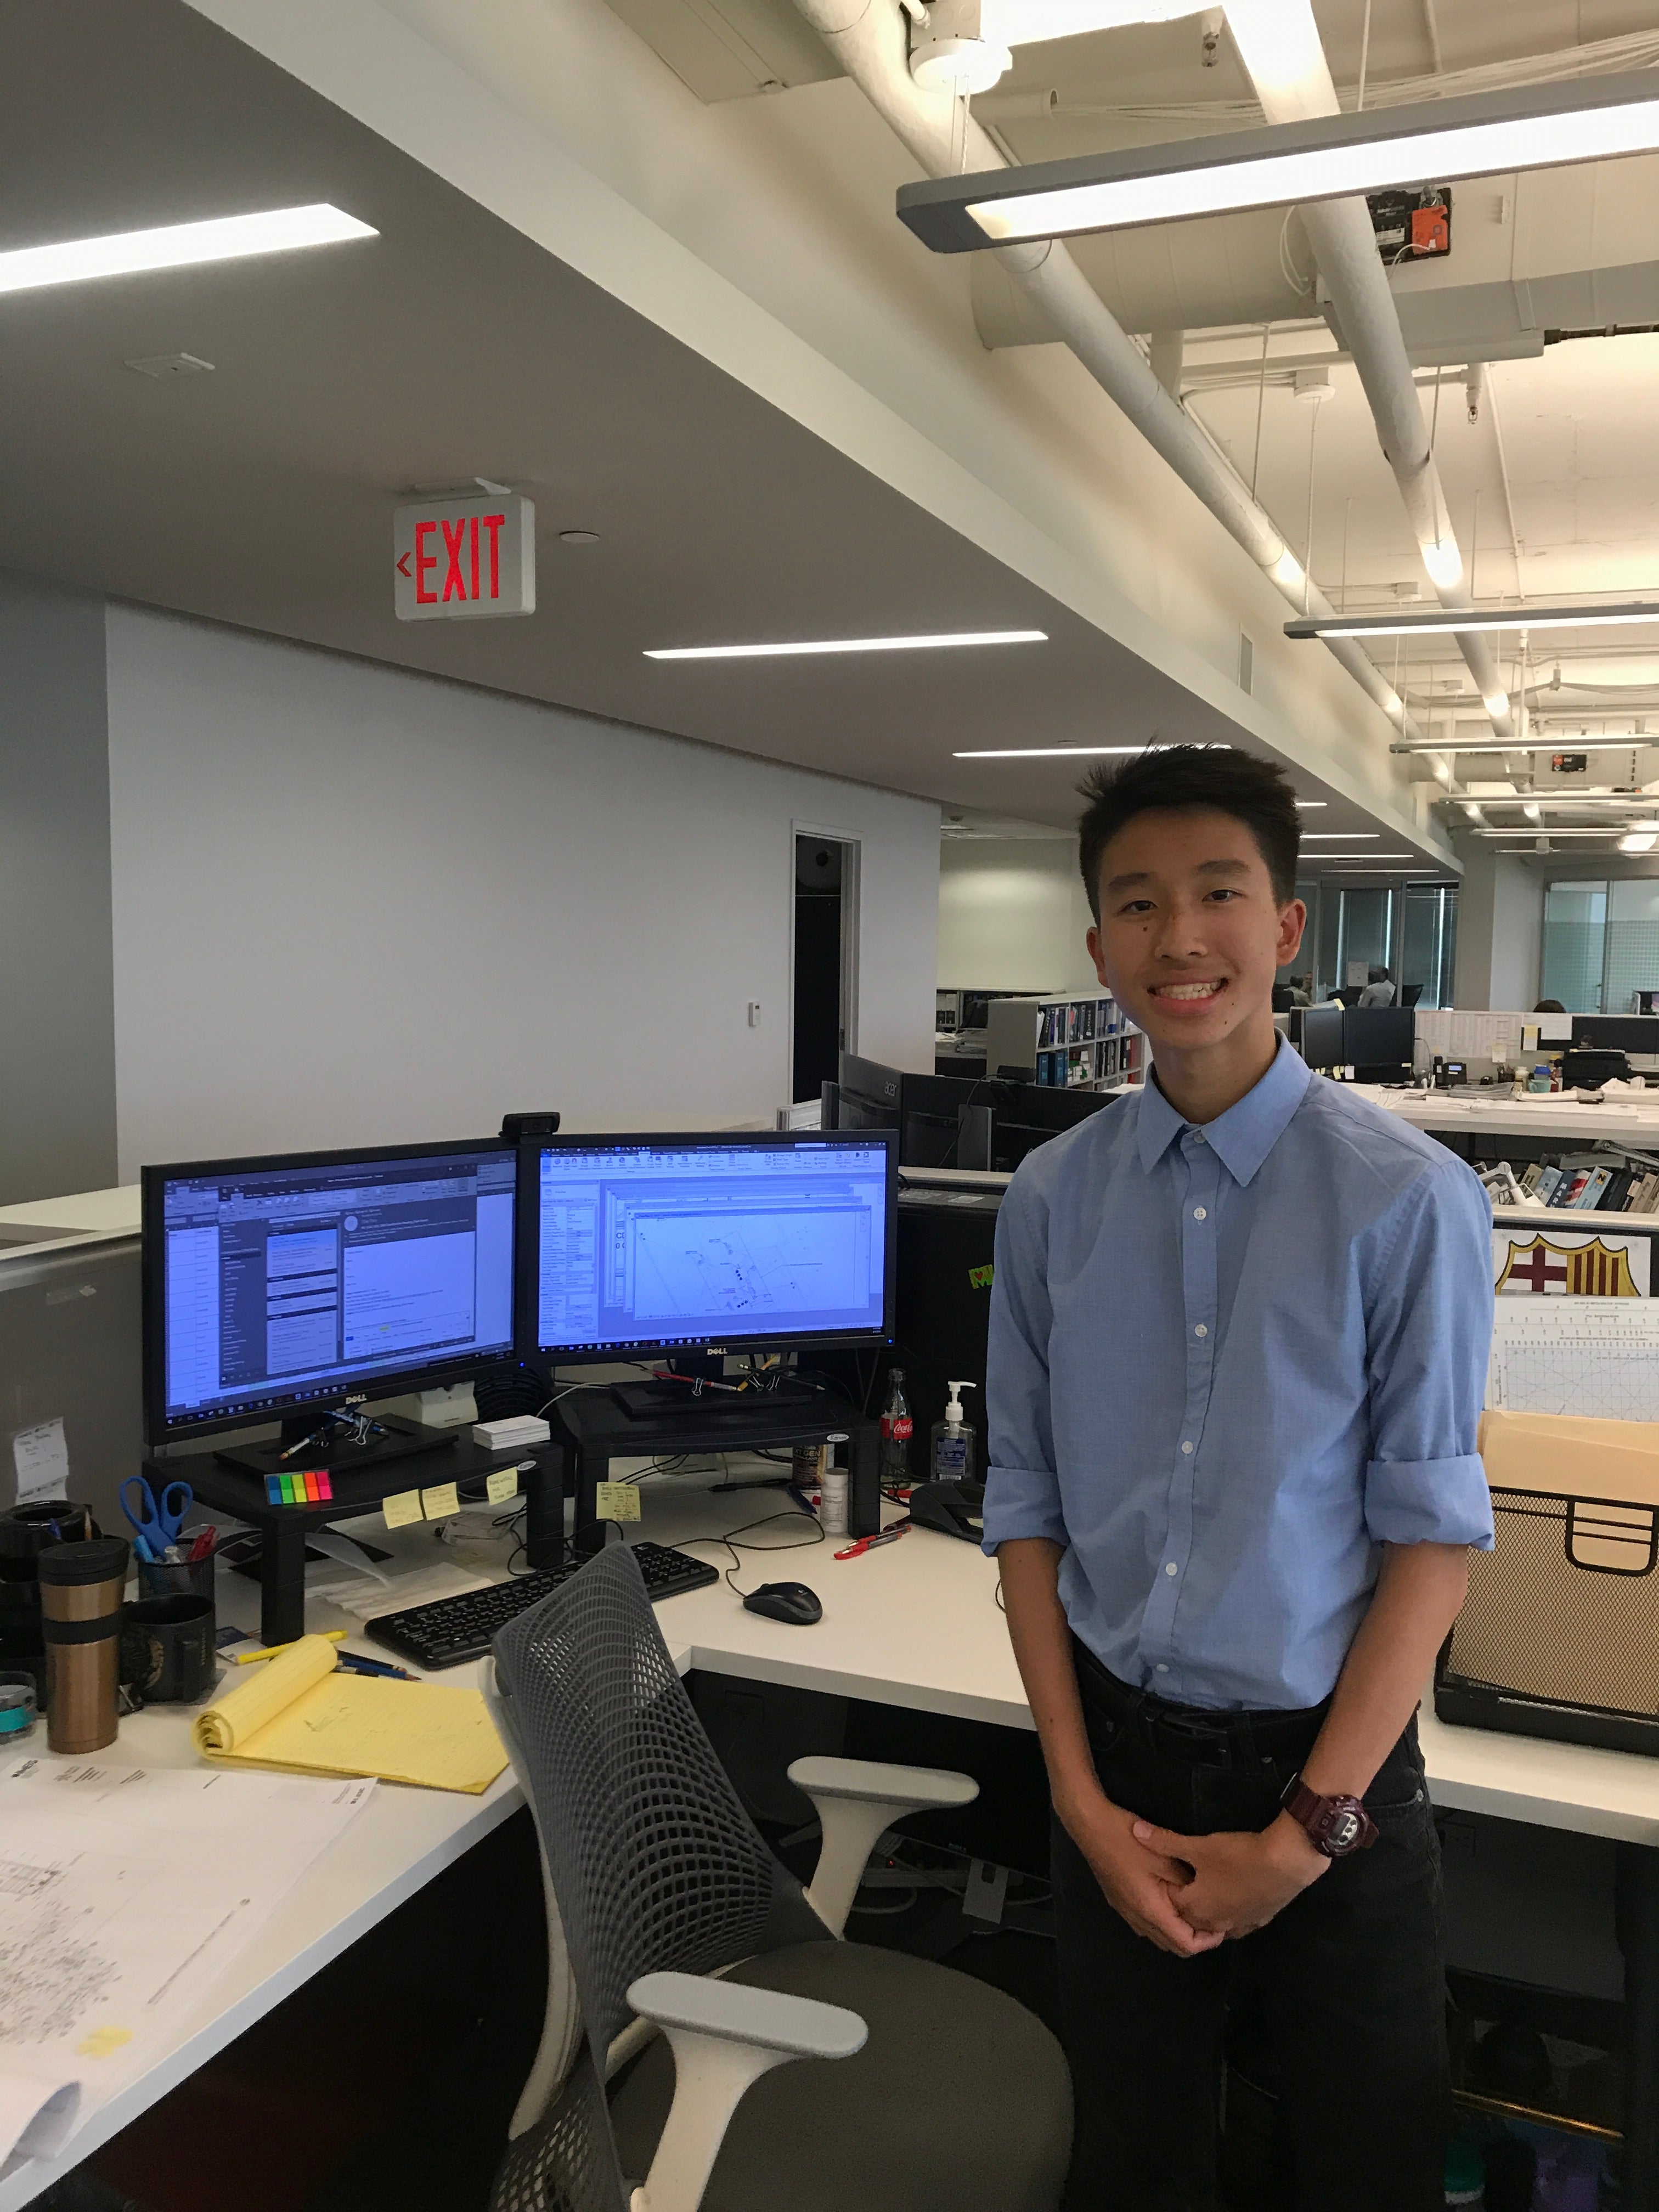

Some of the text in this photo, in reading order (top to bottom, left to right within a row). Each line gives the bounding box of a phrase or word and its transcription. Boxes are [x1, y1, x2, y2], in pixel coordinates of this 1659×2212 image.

[415, 514, 505, 604] EXIT
[884, 1081, 898, 1097] acer
[345, 1393, 367, 1404] DELL
